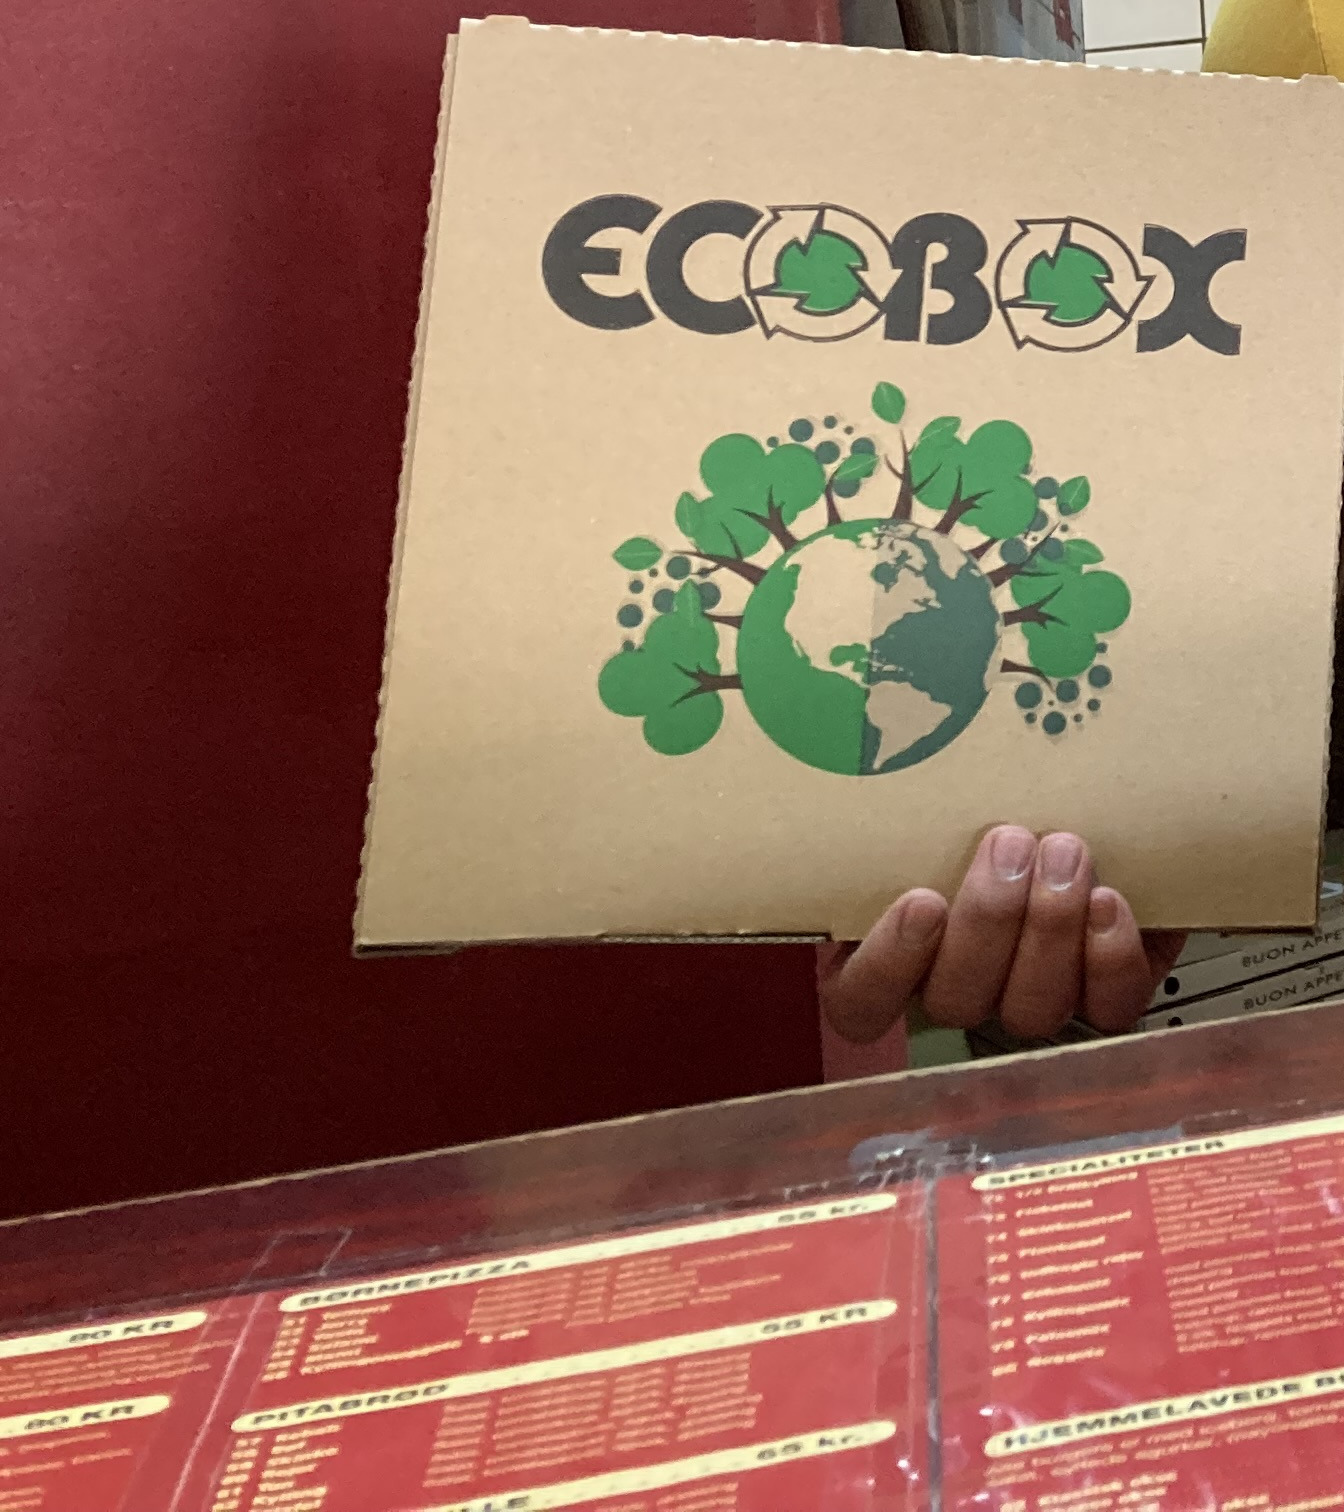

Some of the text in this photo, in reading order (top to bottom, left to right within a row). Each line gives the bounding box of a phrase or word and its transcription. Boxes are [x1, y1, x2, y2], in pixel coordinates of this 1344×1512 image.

[542, 193, 1248, 356] ECOBOX
[1242, 944, 1295, 968] BUON
[1244, 985, 1297, 1010] BUON
[1004, 1381, 1302, 1450] HJEMMELAVEDE
